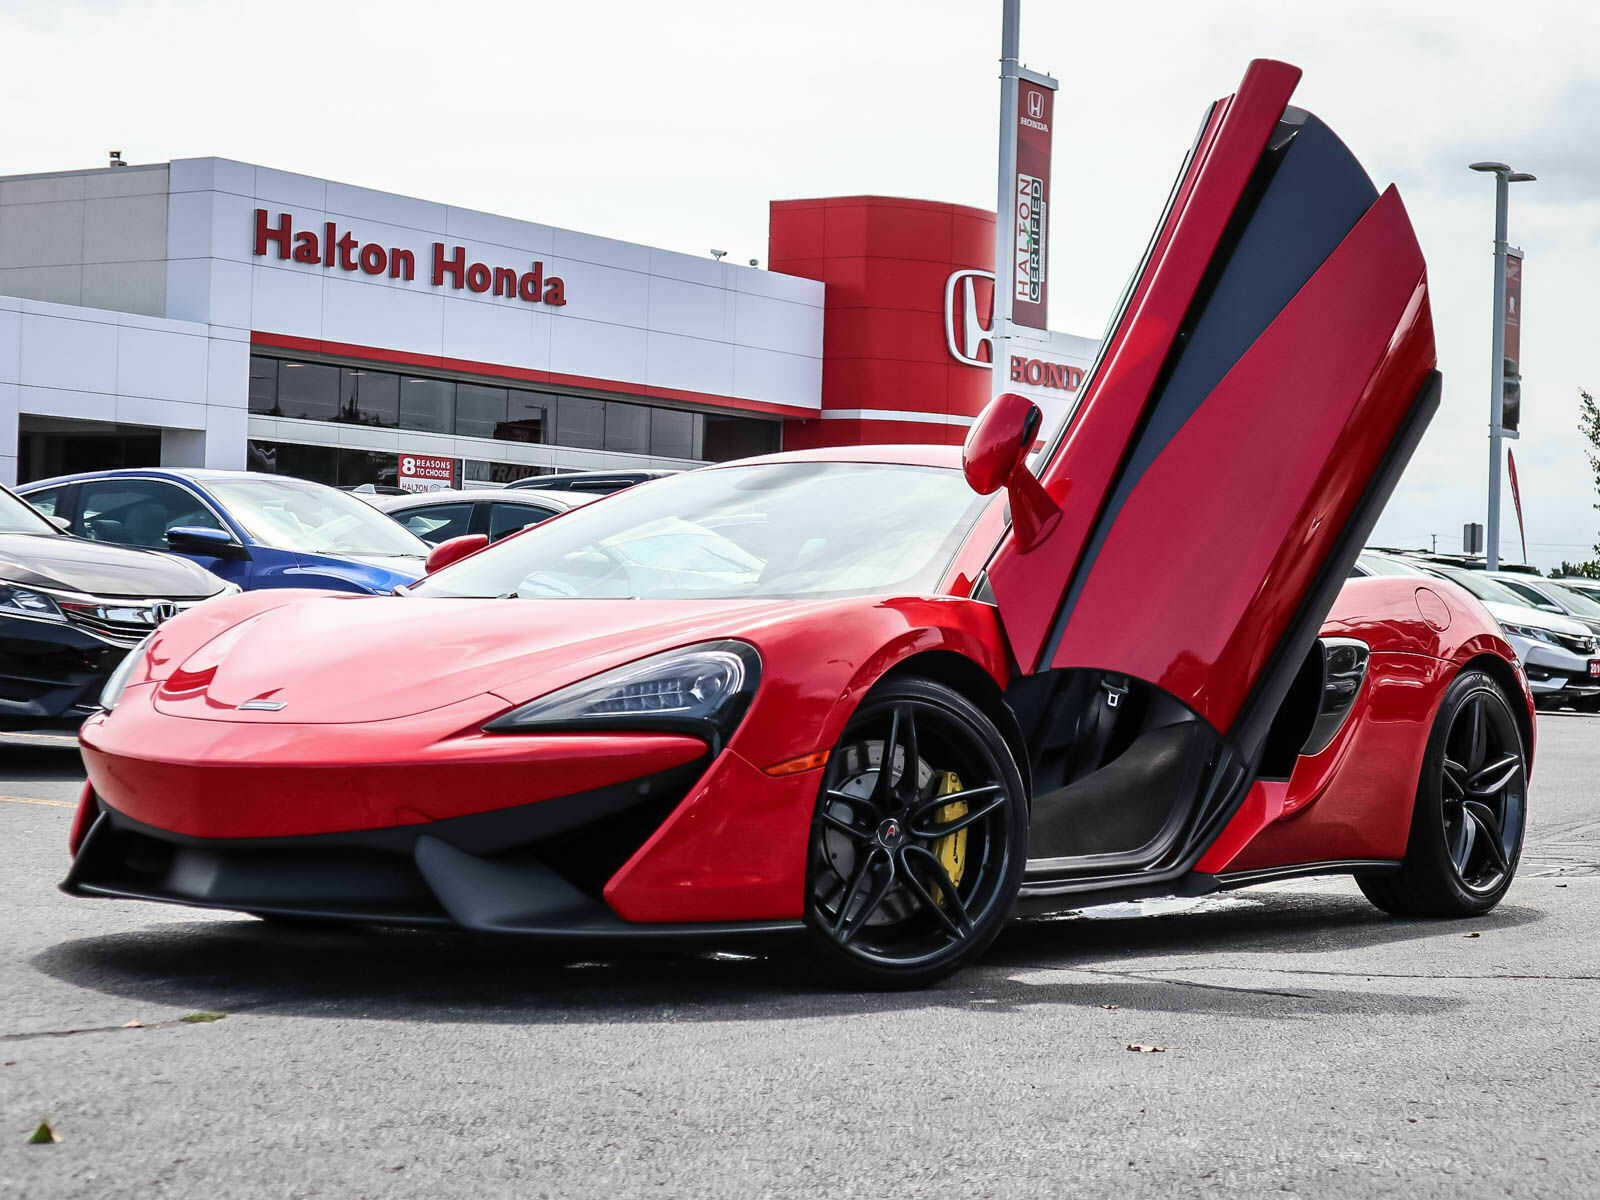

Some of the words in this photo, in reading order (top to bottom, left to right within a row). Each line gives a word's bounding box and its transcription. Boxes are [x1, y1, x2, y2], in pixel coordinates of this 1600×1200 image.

[1020, 116, 1049, 132] HONDA
[1018, 178, 1031, 297] HALTON
[1030, 181, 1041, 299] CERTIFIED
[254, 208, 415, 281] Halton
[431, 242, 567, 306] Honda
[1010, 355, 1087, 392] HOND
[402, 457, 416, 475] 8
[416, 459, 451, 470] REASONS
[416, 467, 425, 476] TO
[425, 469, 451, 478] CHOOSE
[401, 482, 429, 493] HALTON
